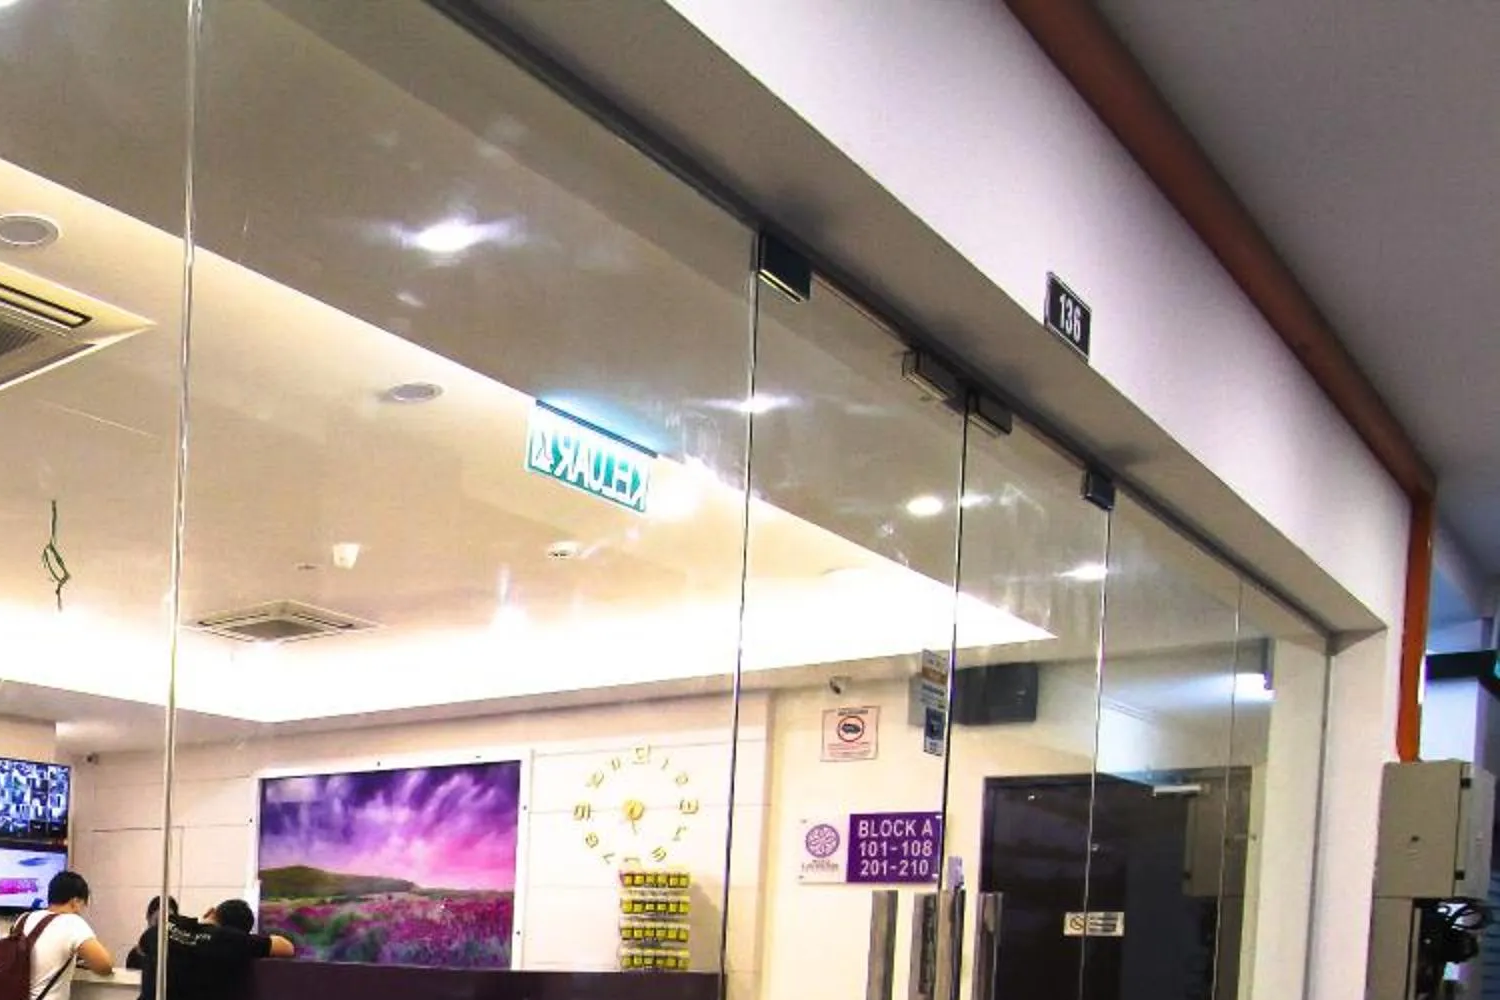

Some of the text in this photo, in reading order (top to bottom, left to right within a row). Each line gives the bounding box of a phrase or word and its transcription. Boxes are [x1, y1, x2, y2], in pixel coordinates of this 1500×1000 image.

[1059, 292, 1082, 343] 136
[858, 818, 934, 838] BLOCK A
[859, 839, 933, 857] 101-108
[859, 859, 930, 877] 201-210
